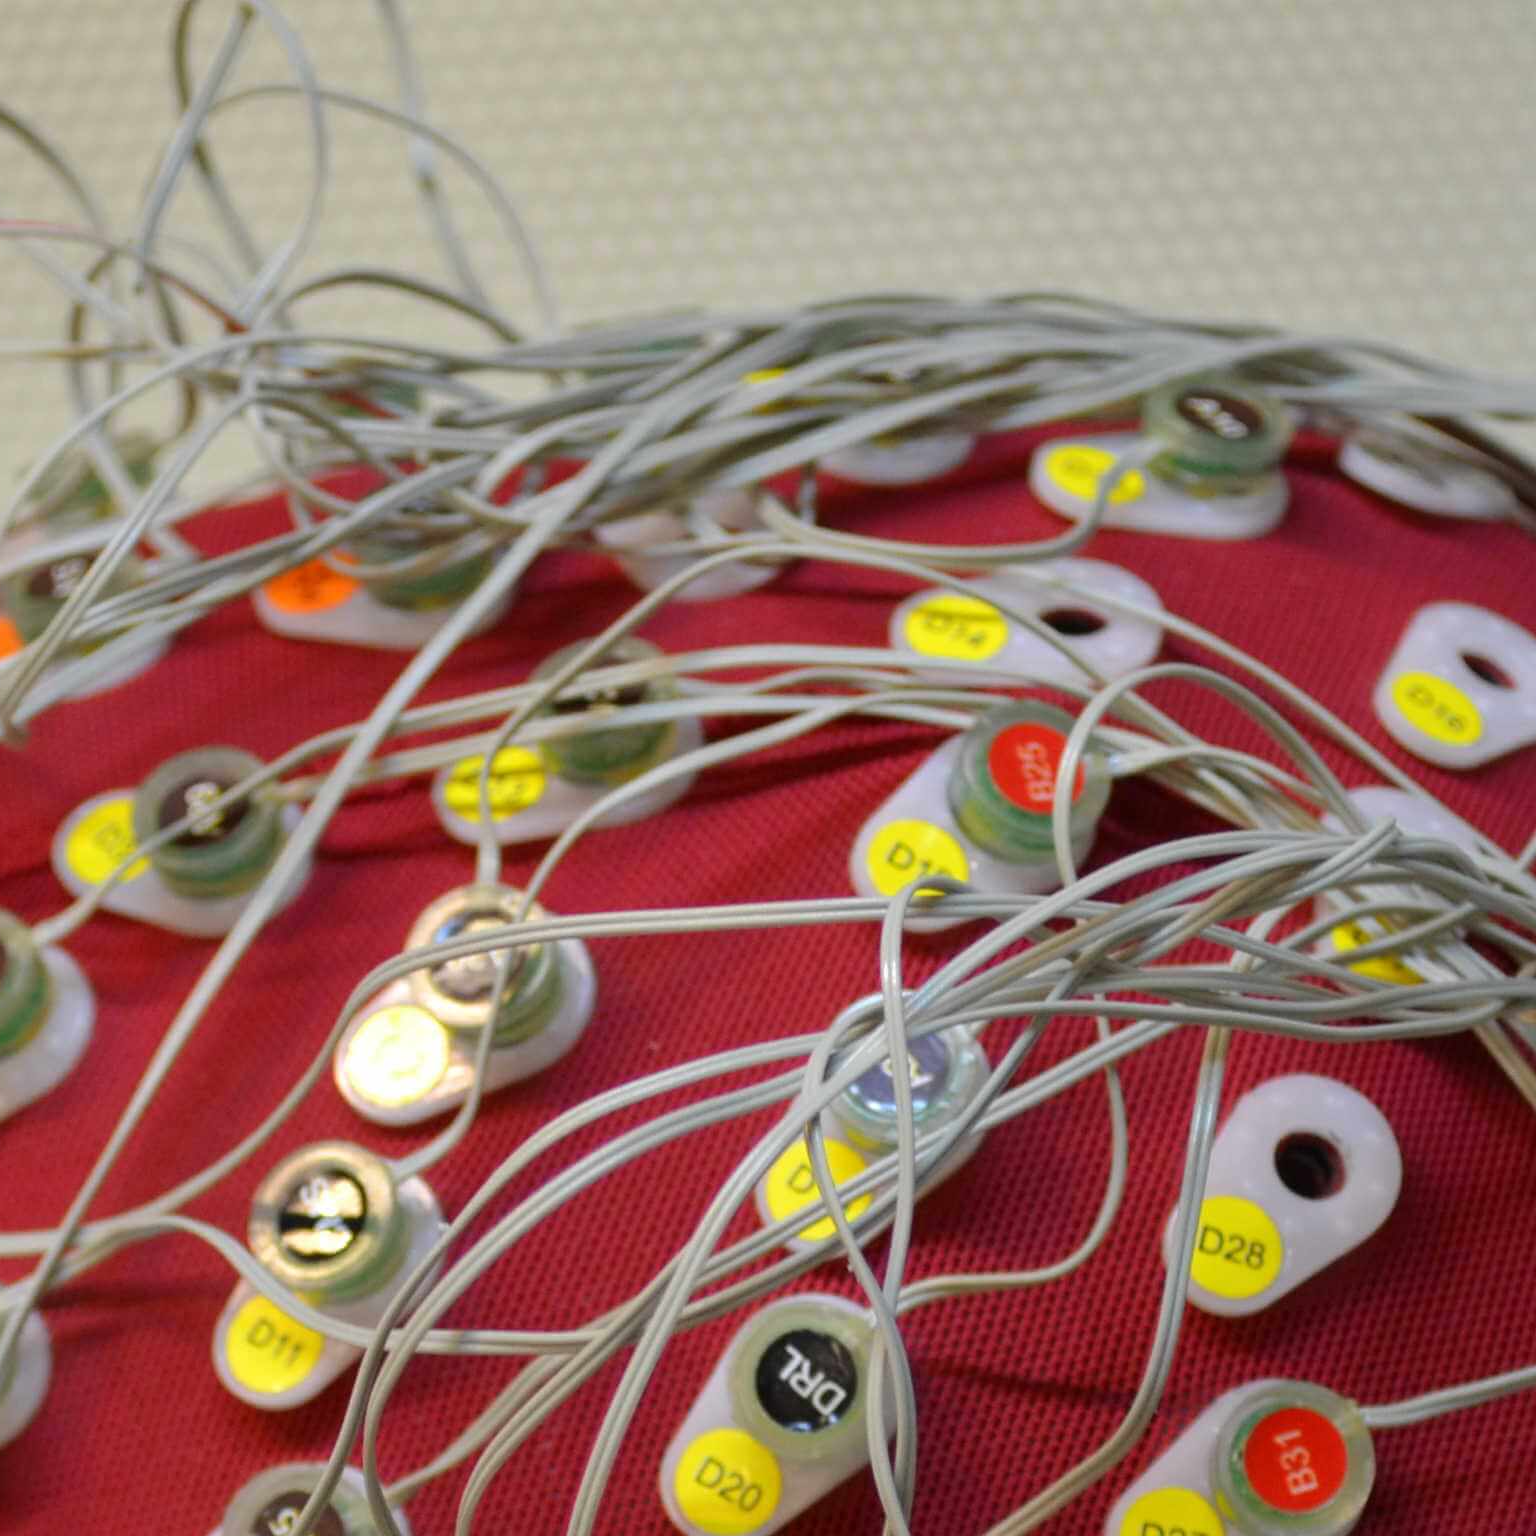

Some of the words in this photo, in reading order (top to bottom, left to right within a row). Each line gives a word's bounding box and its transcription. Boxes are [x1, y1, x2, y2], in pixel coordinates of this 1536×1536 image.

[1016, 742, 1056, 803] B25
[1198, 1226, 1266, 1268] D28
[246, 1319, 303, 1366] D11
[785, 1344, 847, 1418] DRL
[693, 1456, 764, 1513] D20
[1272, 1427, 1320, 1498] B31
